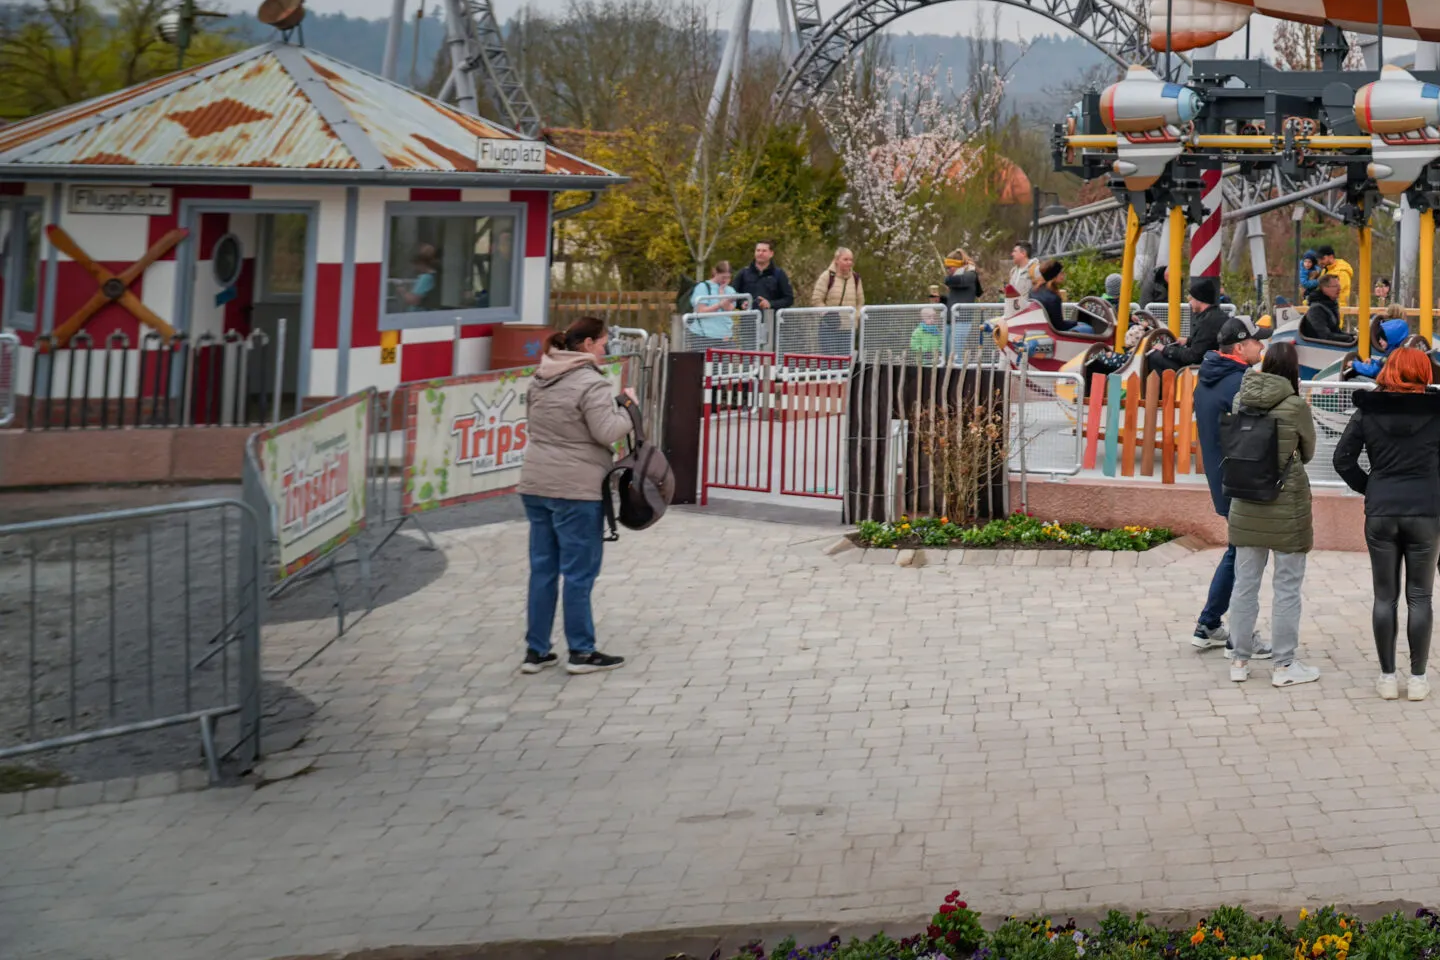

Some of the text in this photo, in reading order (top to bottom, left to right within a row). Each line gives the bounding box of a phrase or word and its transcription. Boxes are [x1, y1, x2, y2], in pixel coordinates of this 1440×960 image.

[481, 142, 541, 166] Flugplatz
[75, 189, 168, 211] Flugplatz
[453, 416, 527, 466] Trips
[283, 450, 350, 532] Tripsdrill
